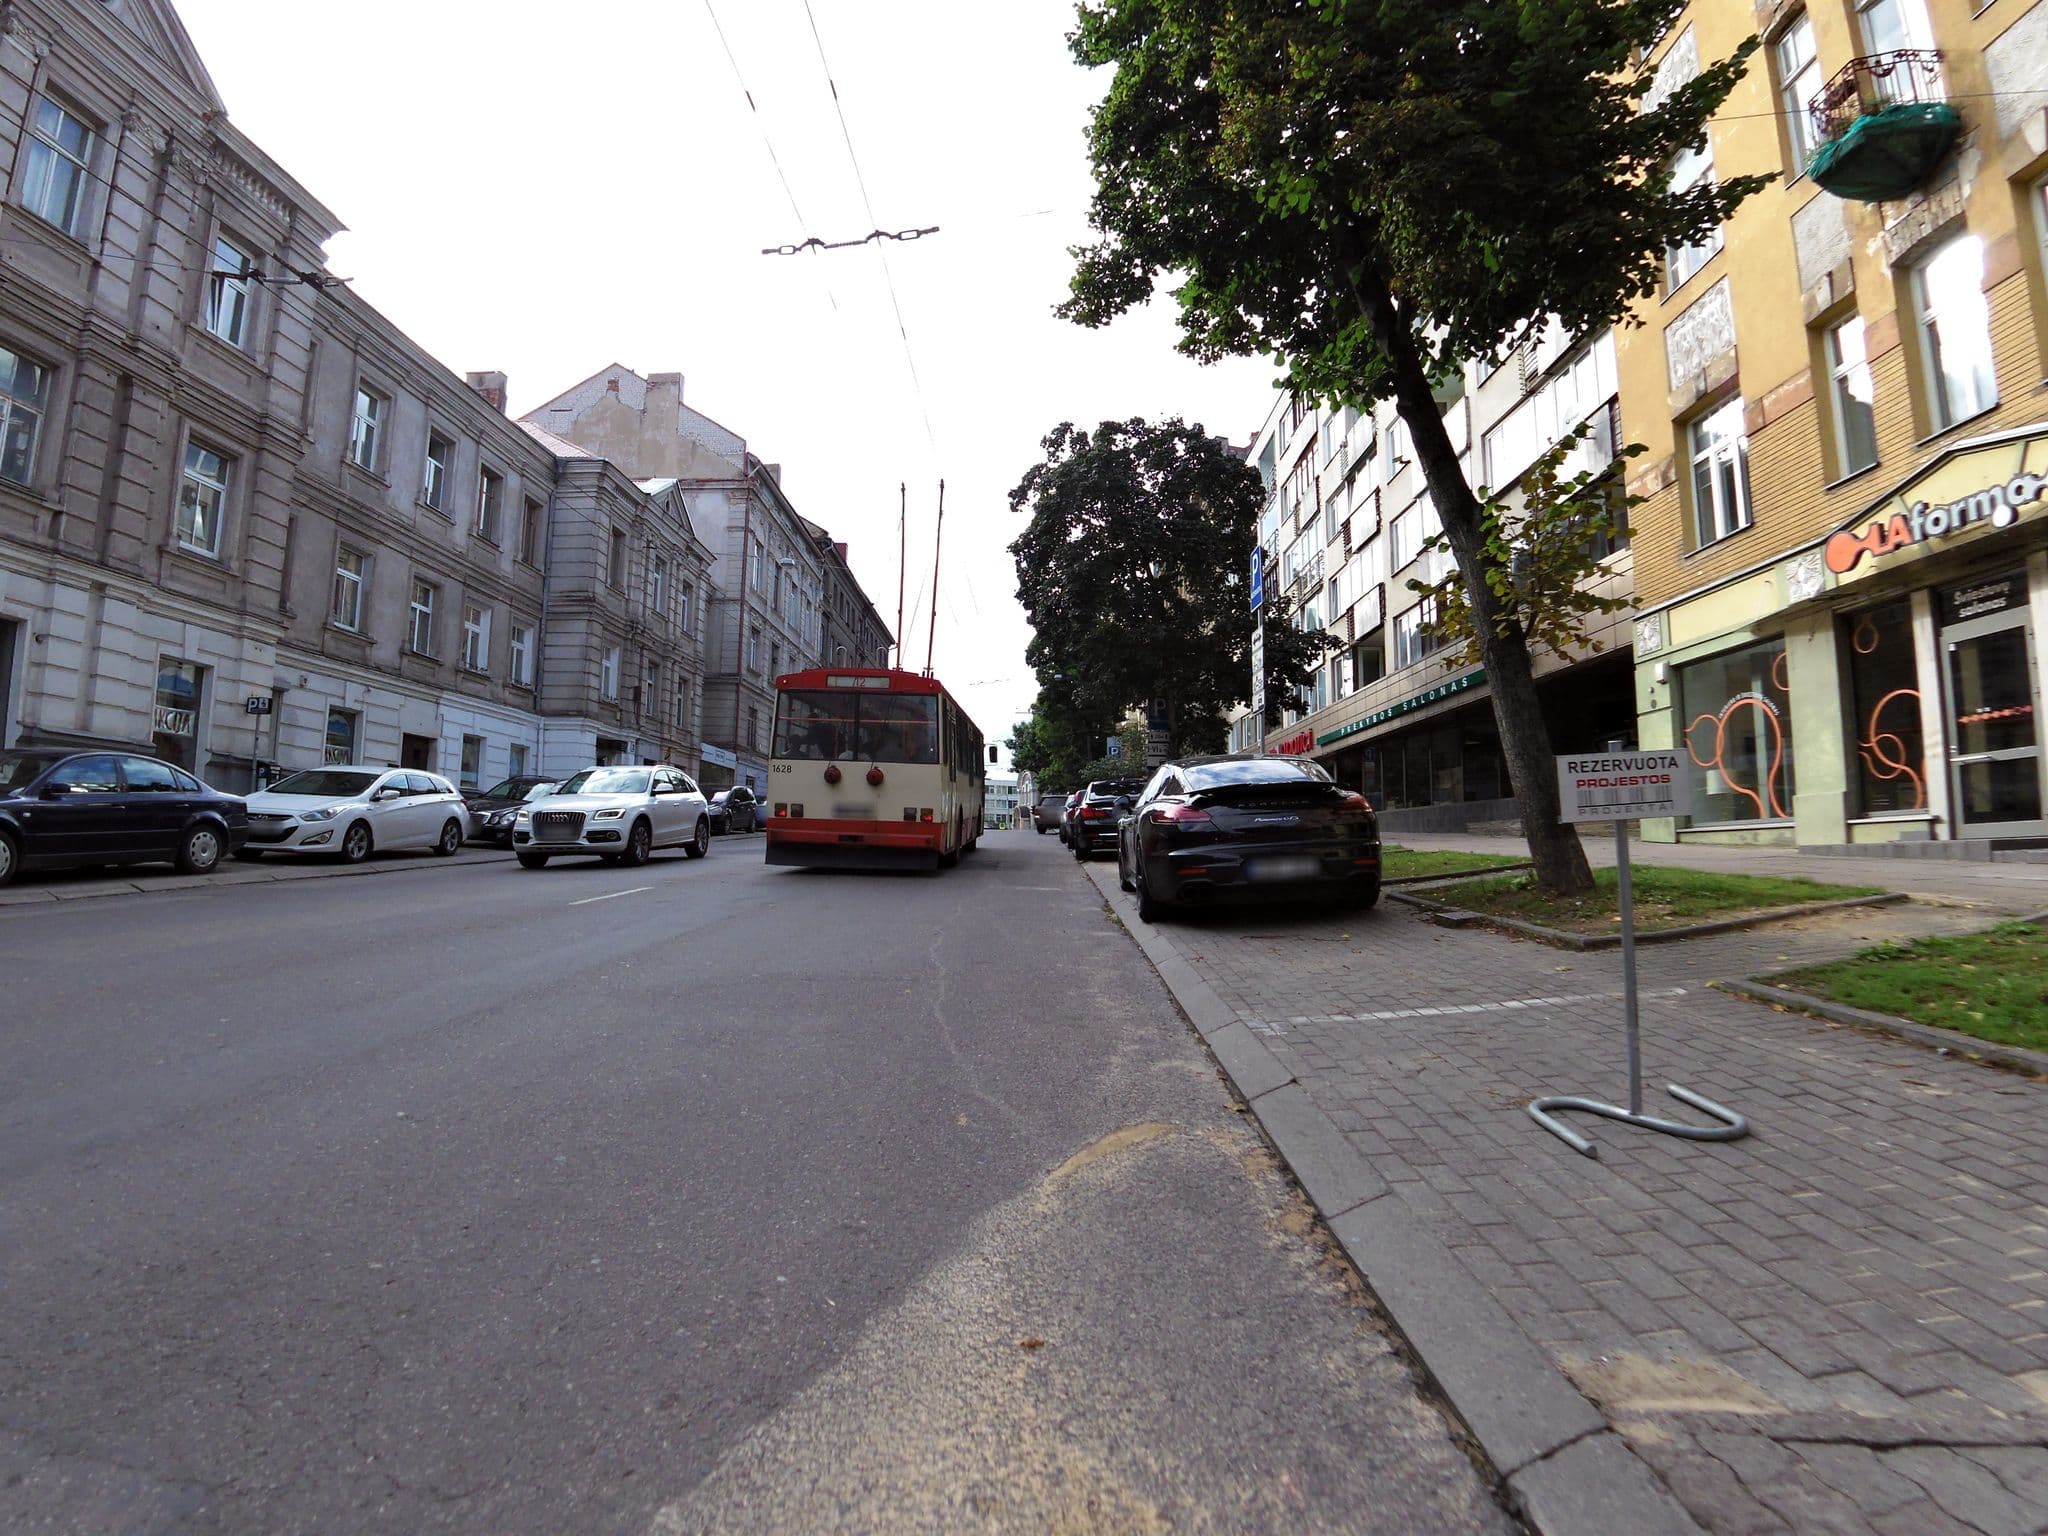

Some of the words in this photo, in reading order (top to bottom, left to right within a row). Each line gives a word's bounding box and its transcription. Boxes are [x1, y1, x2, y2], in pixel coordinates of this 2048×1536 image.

[1252, 555, 1259, 587] P
[249, 699, 258, 714] P
[1340, 708, 1392, 736] PREKYBOS
[1403, 677, 1468, 711] SALONAS
[1111, 747, 1118, 755] P
[772, 765, 792, 773] 1628
[1568, 756, 1679, 774] REZERVUOTA
[1576, 774, 1671, 789] PROJESTOS
[1579, 802, 1675, 816] PROJEKTAI
